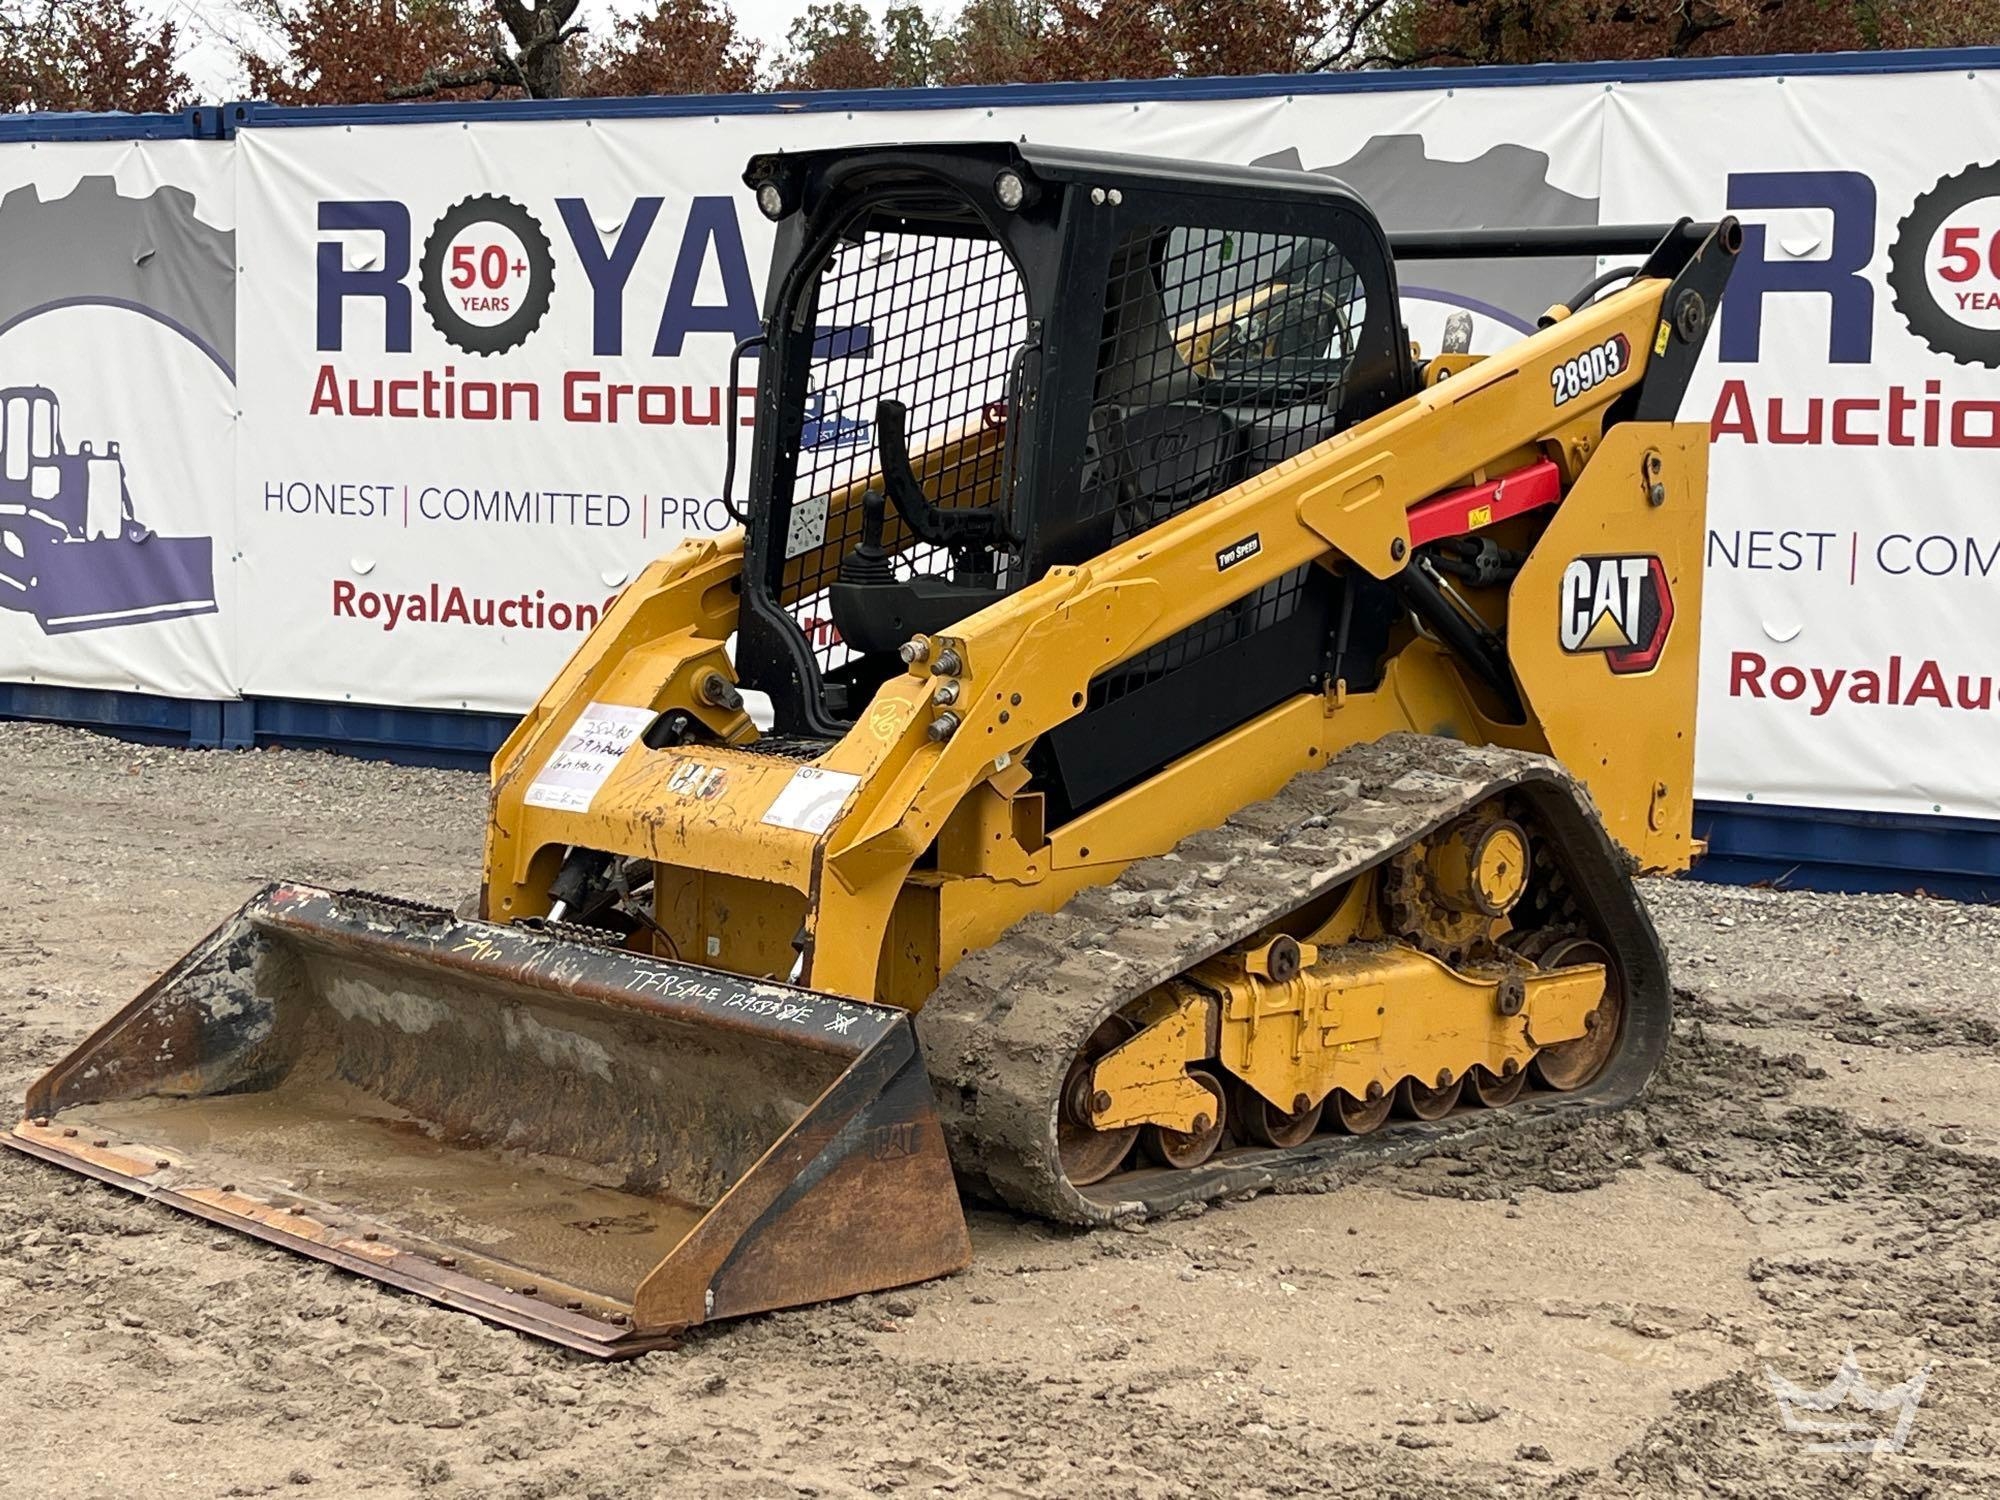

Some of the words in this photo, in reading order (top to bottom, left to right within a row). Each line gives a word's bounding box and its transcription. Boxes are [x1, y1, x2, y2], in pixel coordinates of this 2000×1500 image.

[450, 245, 527, 290] 50+
[461, 297, 510, 311] YEARS
[309, 364, 539, 421] Auction
[1551, 339, 1621, 407] 289D3
[264, 481, 394, 516] HONEST
[419, 487, 631, 527] COMMITTED
[1707, 529, 1836, 571] NEST
[1561, 558, 1648, 651] CAT
[1730, 651, 2000, 716] RoyalAu
